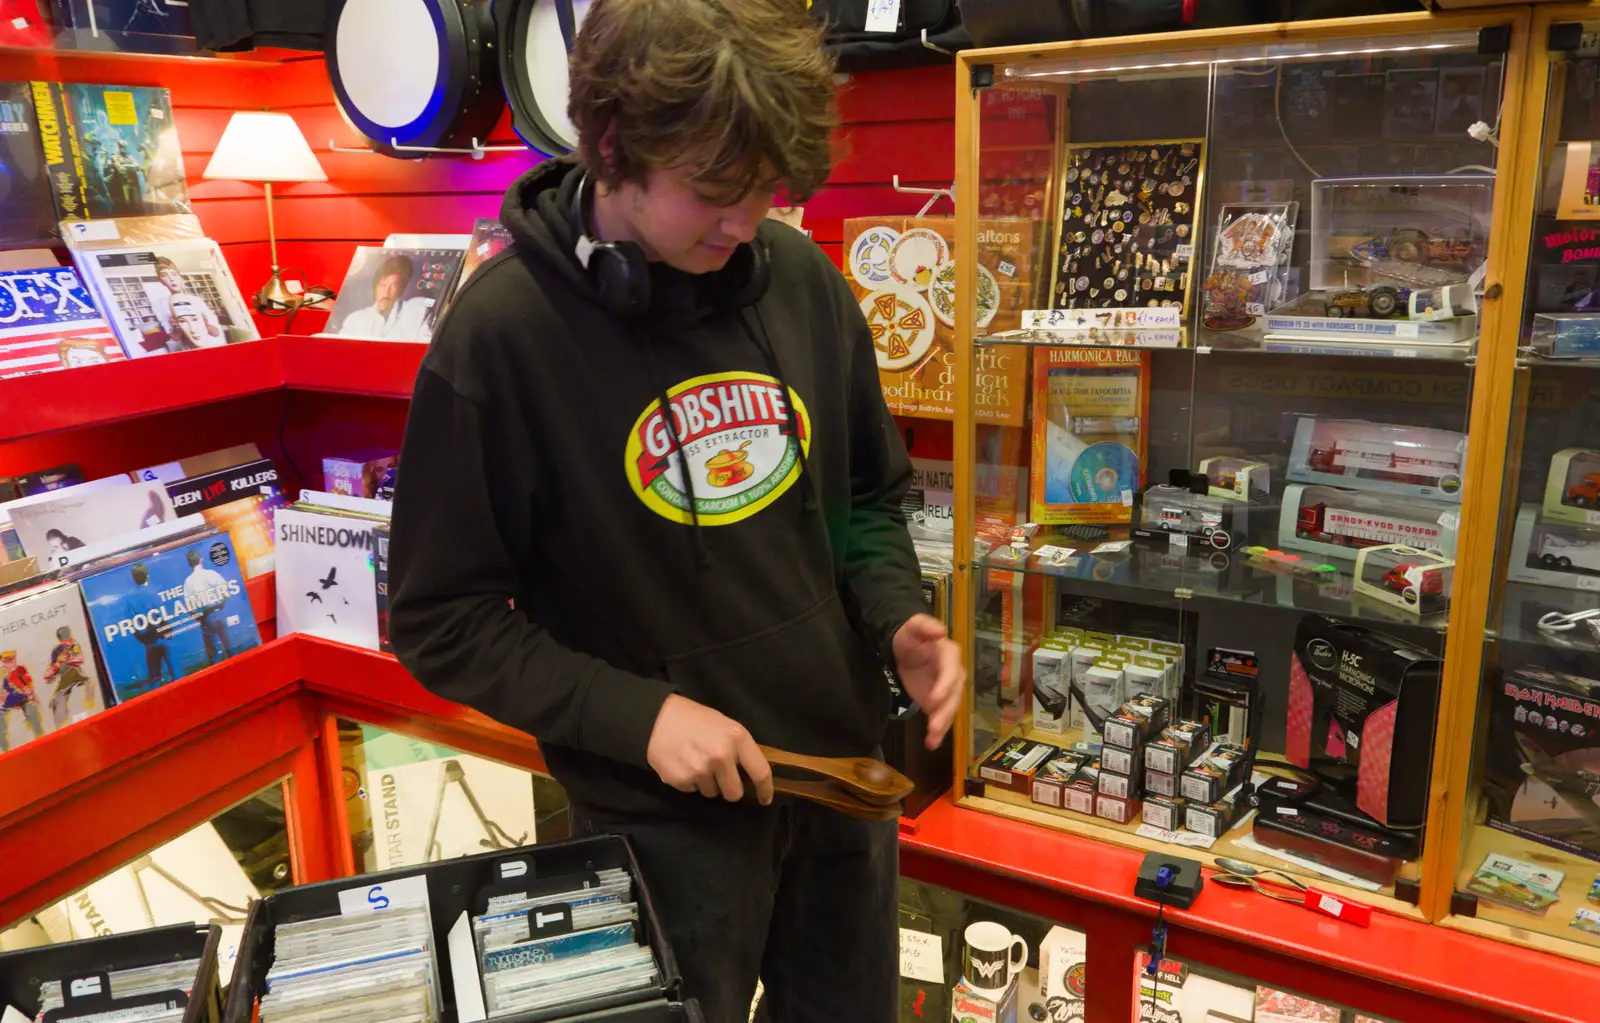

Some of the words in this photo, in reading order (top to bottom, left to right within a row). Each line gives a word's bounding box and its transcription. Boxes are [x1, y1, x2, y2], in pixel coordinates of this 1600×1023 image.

[976, 230, 1021, 244] altons
[1050, 349, 1112, 363] HARMONICA
[1116, 350, 1141, 363] PACK
[645, 383, 788, 458] GOBSHITE
[705, 428, 770, 449] EXTRACTOR
[172, 489, 202, 508] UEEN
[203, 480, 227, 502] LIVE
[230, 469, 278, 491] KILLERS
[698, 497, 739, 511] SARCASM
[1397, 523, 1438, 537] FORFAR
[157, 584, 184, 602] THE
[30, 603, 67, 625] CRAFT
[103, 579, 241, 643] PROCLAIMERS
[1339, 672, 1375, 695] MICROPHONE
[1340, 663, 1376, 686] HARMONICA
[1504, 683, 1543, 707] IRON
[381, 773, 402, 832] STAND
[500, 860, 528, 879] U
[367, 886, 390, 910] S
[536, 911, 564, 928] T
[70, 976, 101, 997] R
[1164, 973, 1181, 984] HELL
